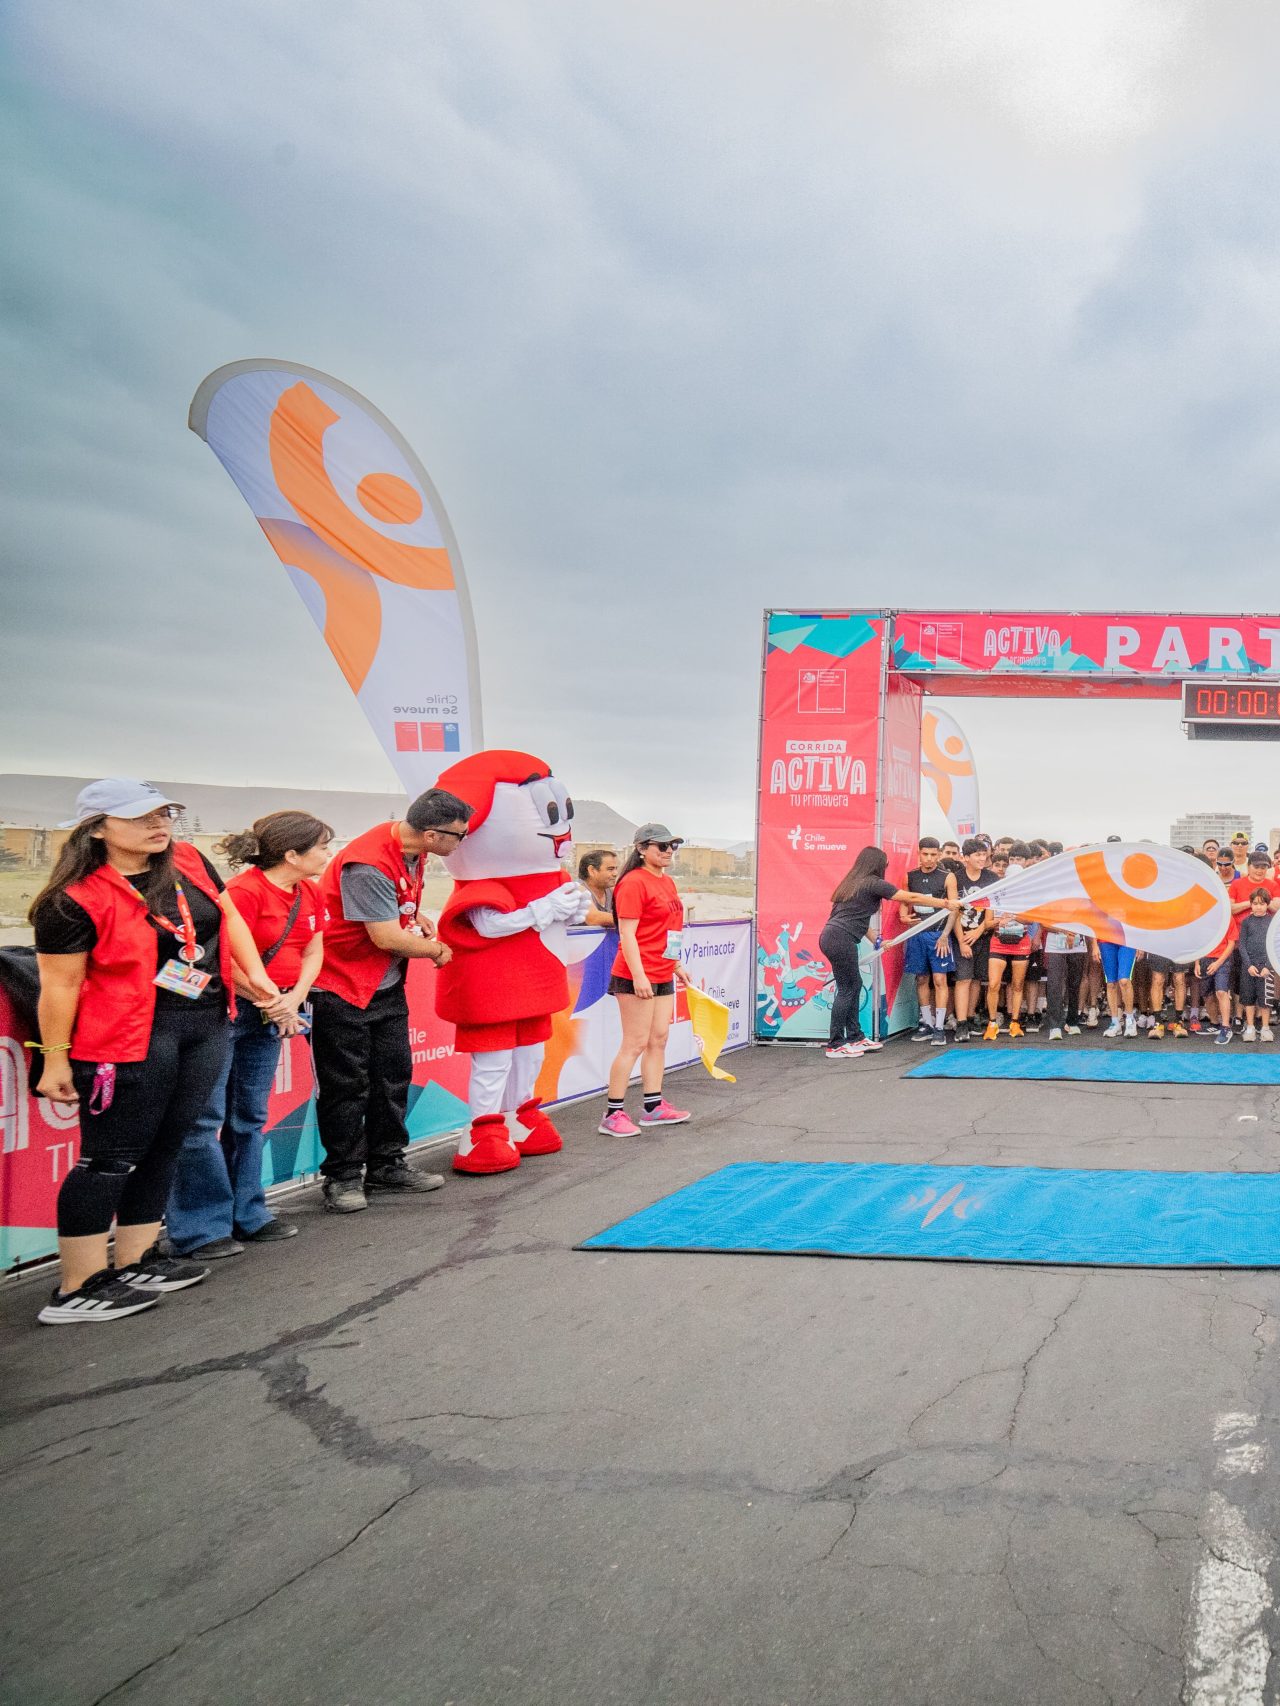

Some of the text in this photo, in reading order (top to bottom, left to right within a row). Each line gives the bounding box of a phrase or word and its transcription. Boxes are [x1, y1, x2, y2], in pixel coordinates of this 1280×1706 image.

[983, 626, 1062, 657] ACTIVA
[790, 743, 842, 751] CORRIDA
[770, 755, 867, 795] ACTIVA
[790, 794, 801, 807] TU
[804, 833, 826, 842] Chile
[804, 842, 847, 851] Se mueve
[684, 941, 736, 964] y Parinacota
[409, 1028, 427, 1045] ile
[412, 1044, 463, 1065] muev
